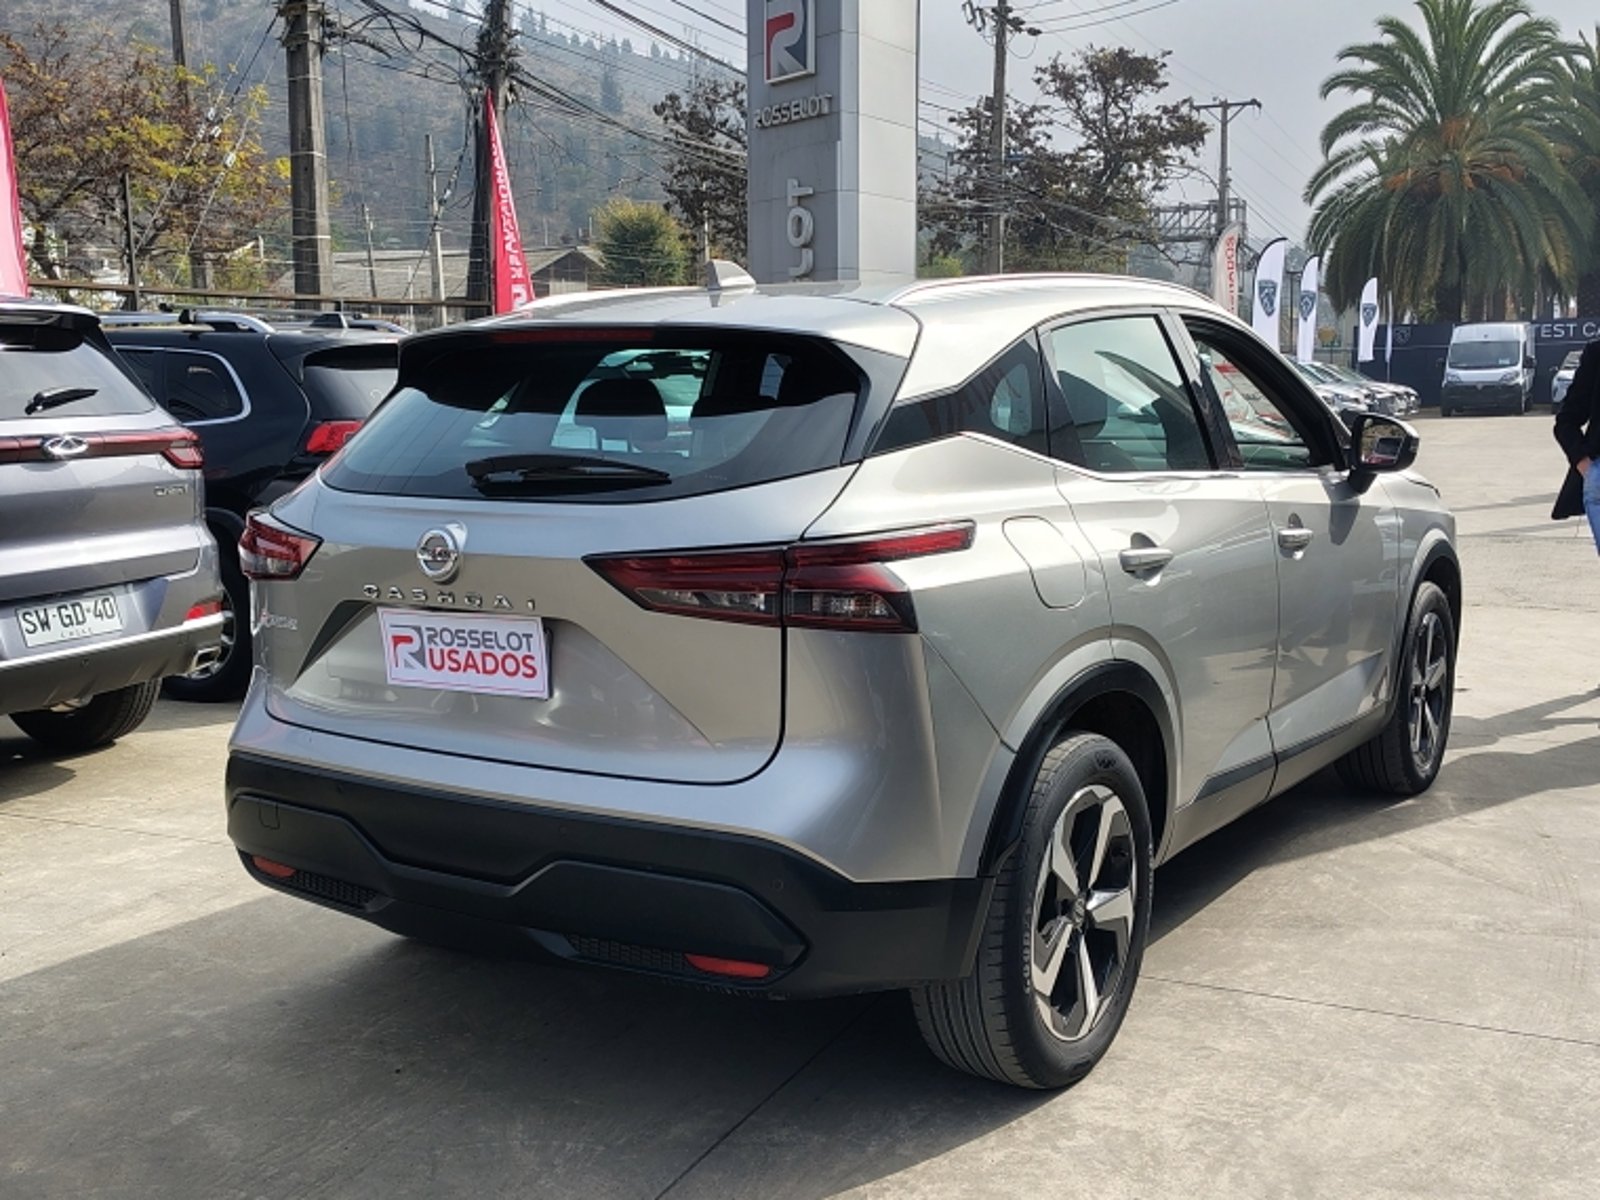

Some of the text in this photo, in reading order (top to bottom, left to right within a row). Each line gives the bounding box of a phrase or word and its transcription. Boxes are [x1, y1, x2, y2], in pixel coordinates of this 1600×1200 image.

[753, 94, 832, 128] ROSSELOT
[425, 627, 533, 653] ROSSELOT
[428, 647, 538, 679] USADOS
